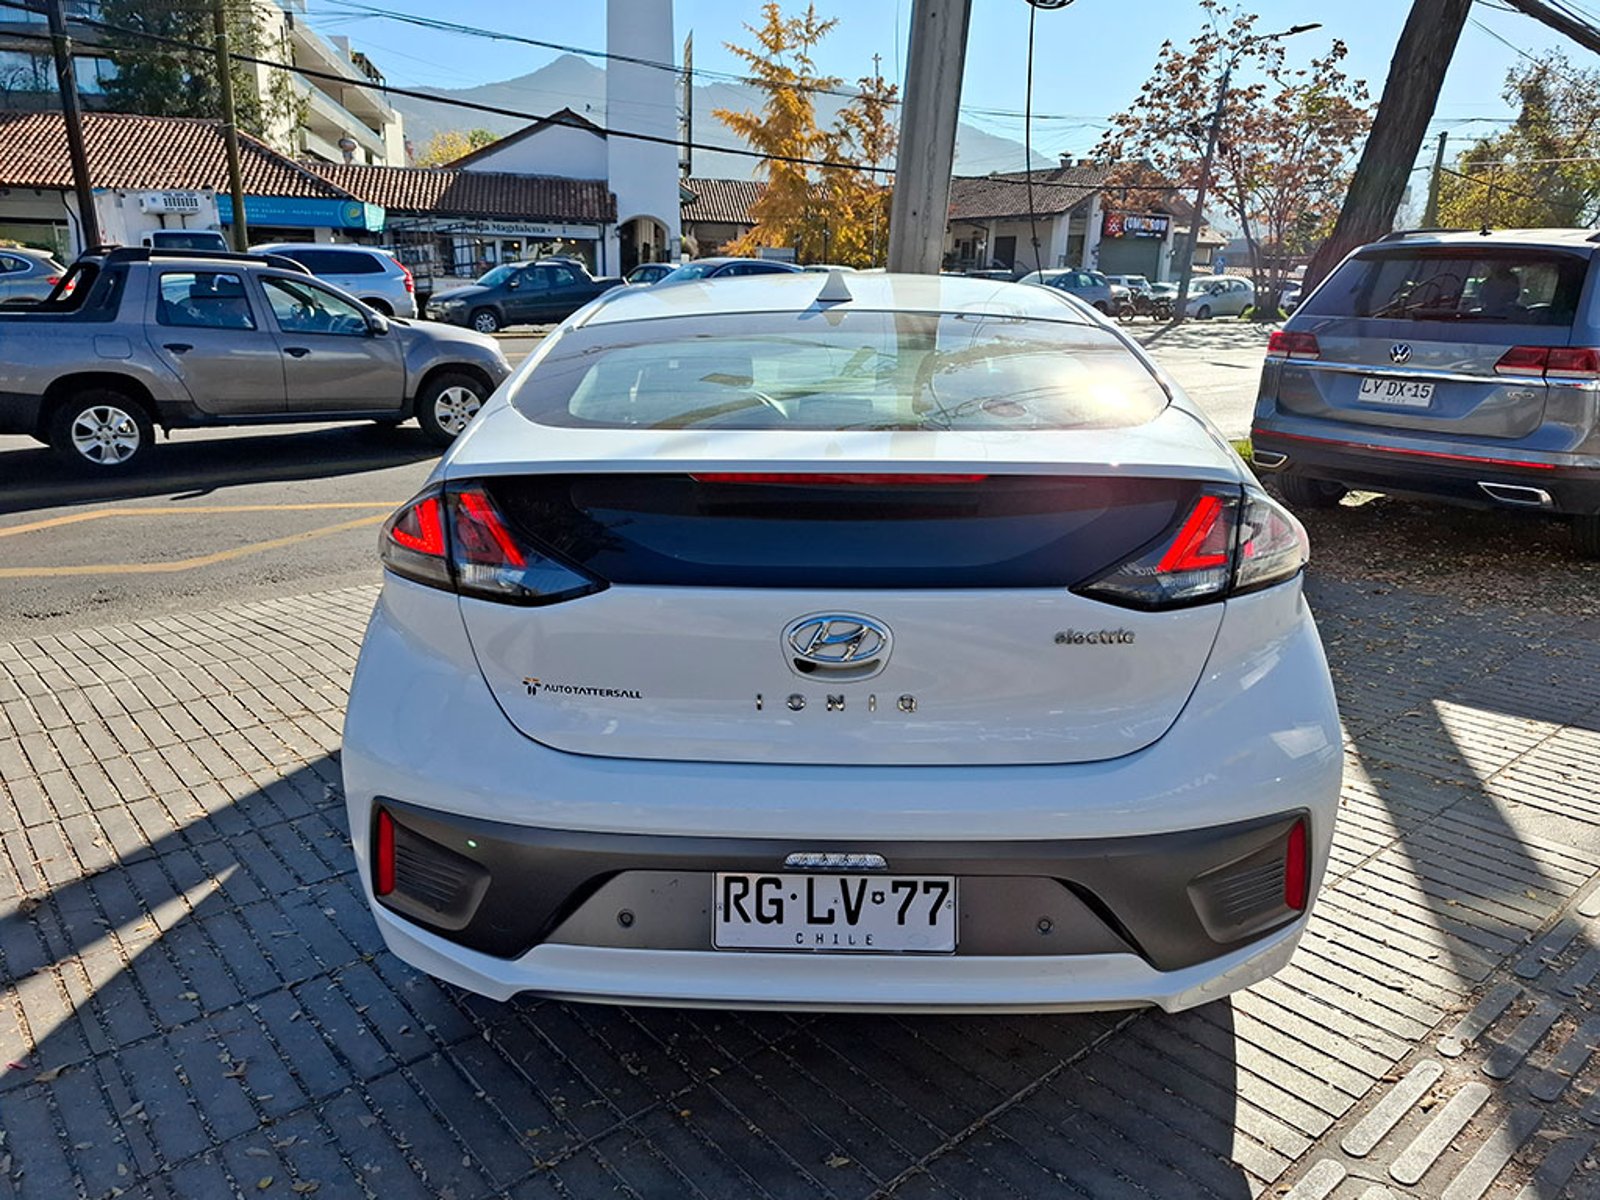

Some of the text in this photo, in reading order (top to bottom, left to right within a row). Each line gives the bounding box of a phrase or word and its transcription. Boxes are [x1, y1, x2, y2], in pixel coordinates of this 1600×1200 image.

[1055, 627, 1136, 645] electric
[543, 683, 643, 699] AUTOTATTERSALL
[756, 693, 918, 713] IONIQ
[795, 932, 874, 946] CHILE
